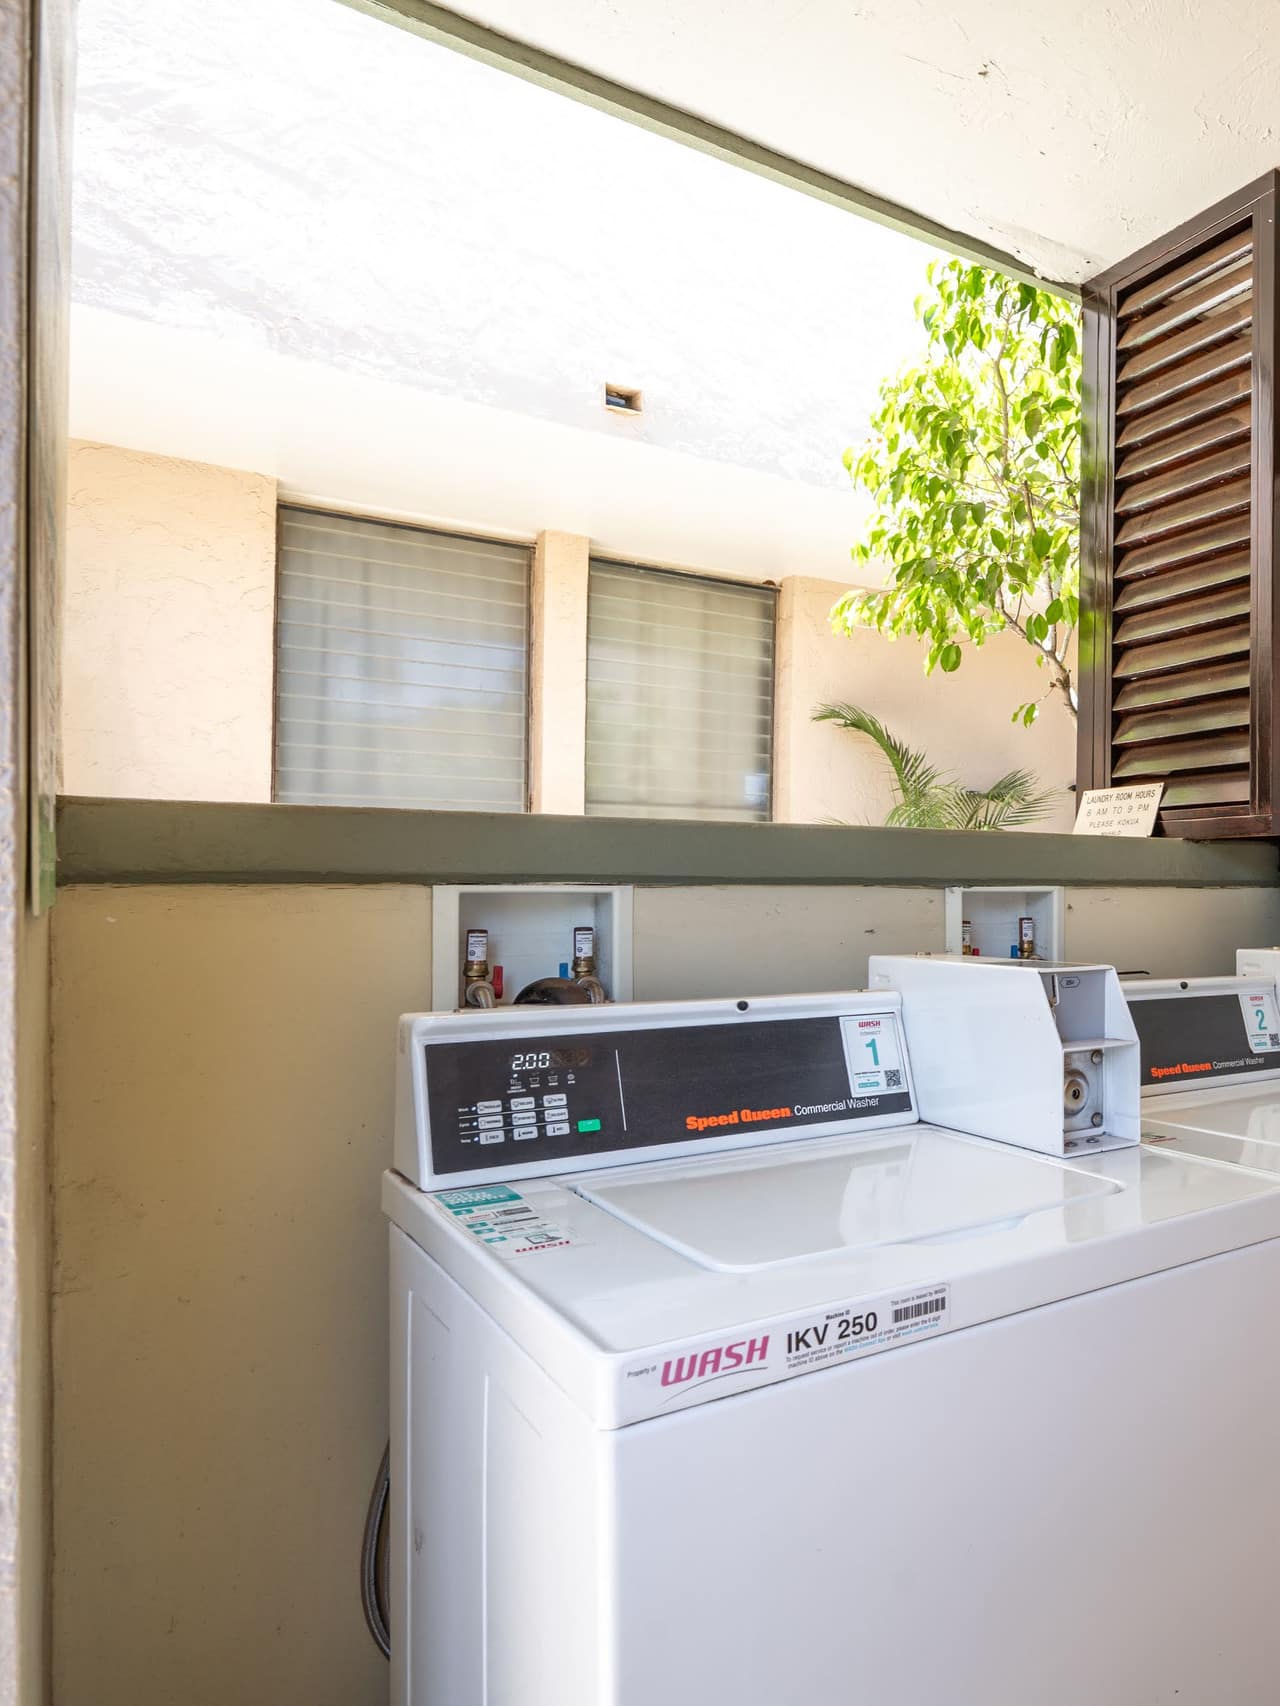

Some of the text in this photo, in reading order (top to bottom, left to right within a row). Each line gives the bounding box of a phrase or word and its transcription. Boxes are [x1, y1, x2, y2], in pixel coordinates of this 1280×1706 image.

[1086, 789, 1156, 804] LAUNDRY ROOM HOURS
[1096, 807, 1108, 816] AM
[1112, 806, 1122, 815] TO
[1137, 803, 1150, 812] PM
[1089, 820, 1113, 828] PLEASE
[858, 1020, 881, 1028] WASH
[1255, 1009, 1268, 1031] 2
[512, 1052, 550, 1070] 2.00
[865, 1038, 880, 1066] 1
[1151, 1056, 1265, 1078] Speed Queen Commercial Washer
[686, 1097, 880, 1131] Speed Queen Commercial Washer
[825, 1312, 845, 1321] Machine
[787, 1311, 878, 1354] IKV 250
[660, 1335, 770, 1387] WASH
[627, 1367, 650, 1378] Property
